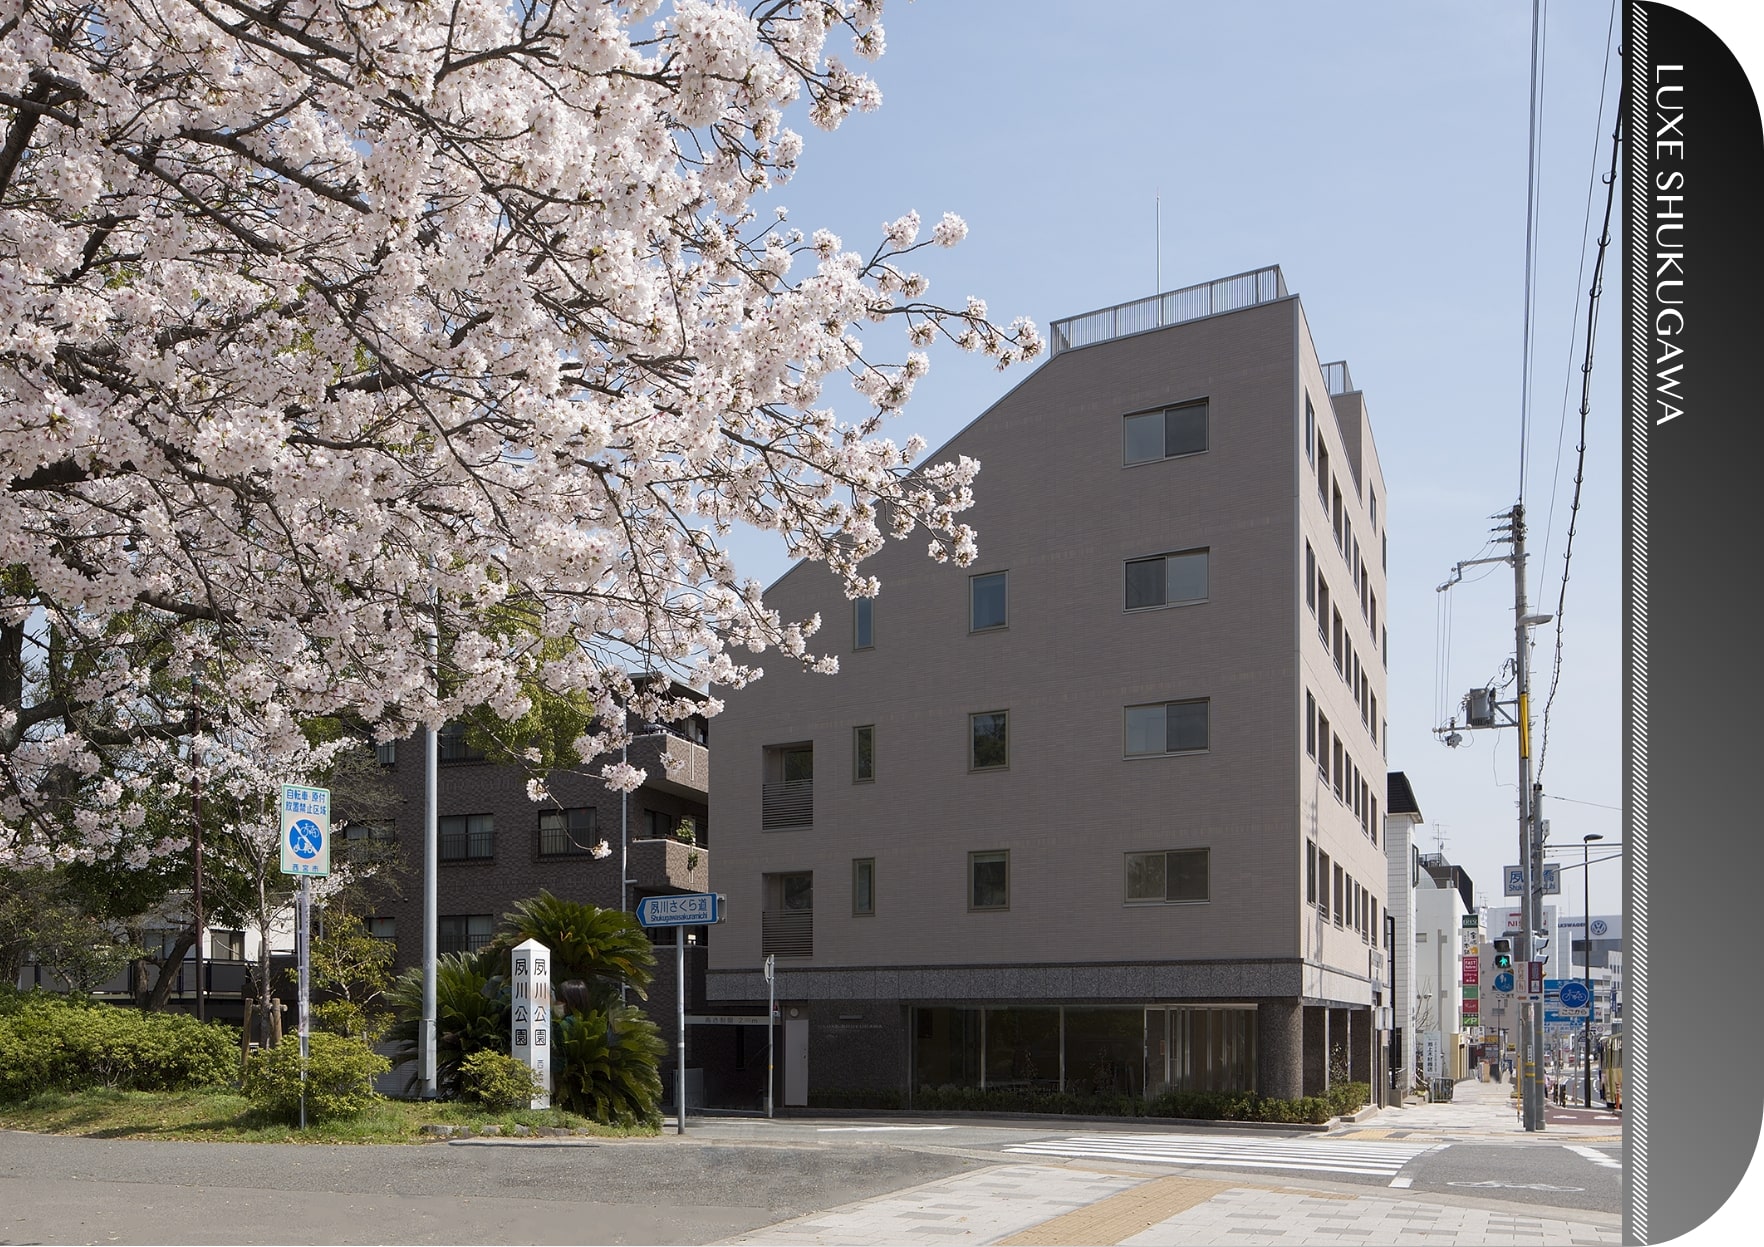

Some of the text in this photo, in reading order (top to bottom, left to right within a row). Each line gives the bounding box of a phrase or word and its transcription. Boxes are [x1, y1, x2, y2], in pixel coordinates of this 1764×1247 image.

[285, 801, 327, 816] 放置禁止区域
[650, 898, 707, 914] 夙川さくら道
[650, 911, 708, 923] Shukugawasakuramichi
[514, 958, 528, 1046] 夙川公園
[533, 958, 547, 1046] 夙川公園
